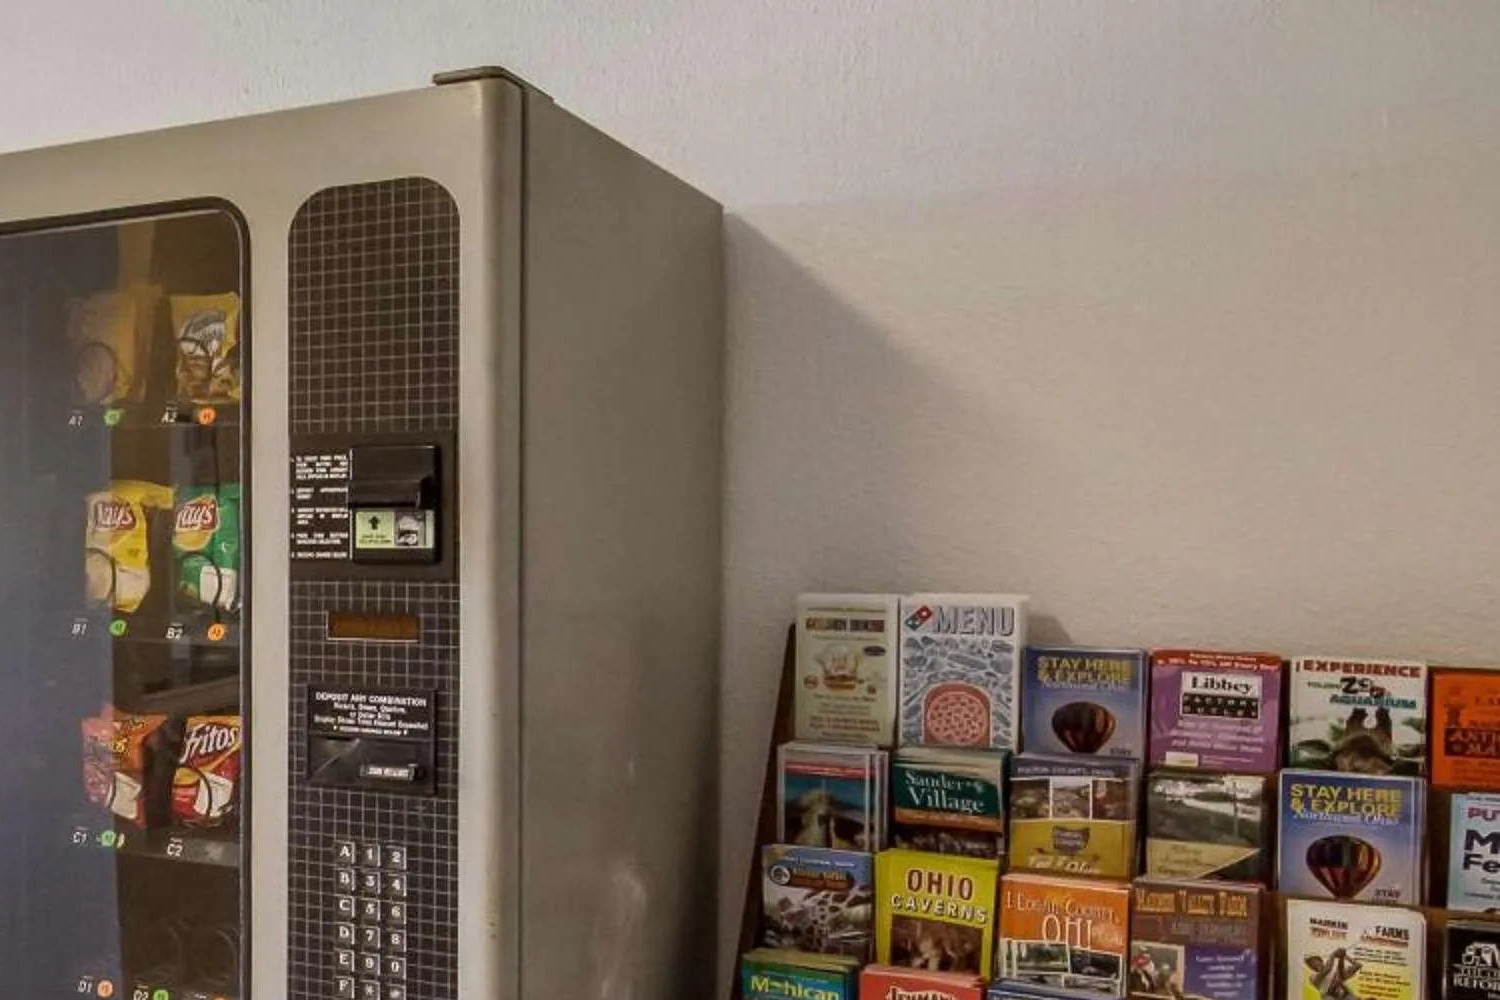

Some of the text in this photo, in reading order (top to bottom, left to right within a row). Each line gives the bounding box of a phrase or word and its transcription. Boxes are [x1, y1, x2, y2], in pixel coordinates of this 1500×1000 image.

[933, 605, 1015, 637] MENU
[1303, 659, 1422, 678] EXPERIENCE
[1191, 675, 1253, 695] Libbey
[179, 721, 238, 764] Fritos
[908, 786, 985, 815] Village
[1290, 783, 1402, 802] STAY HERE
[167, 842, 183, 857] C2
[340, 846, 350, 857] A
[392, 851, 401, 863] 2
[366, 875, 375, 887] 3
[391, 879, 401, 891] 4
[907, 868, 974, 901] OHIO
[339, 899, 350, 911] C
[391, 905, 401, 917] 6
[891, 894, 988, 925] CAVERNS
[339, 926, 401, 945] D 7 8
[339, 953, 349, 965] E
[391, 961, 399, 972] 0
